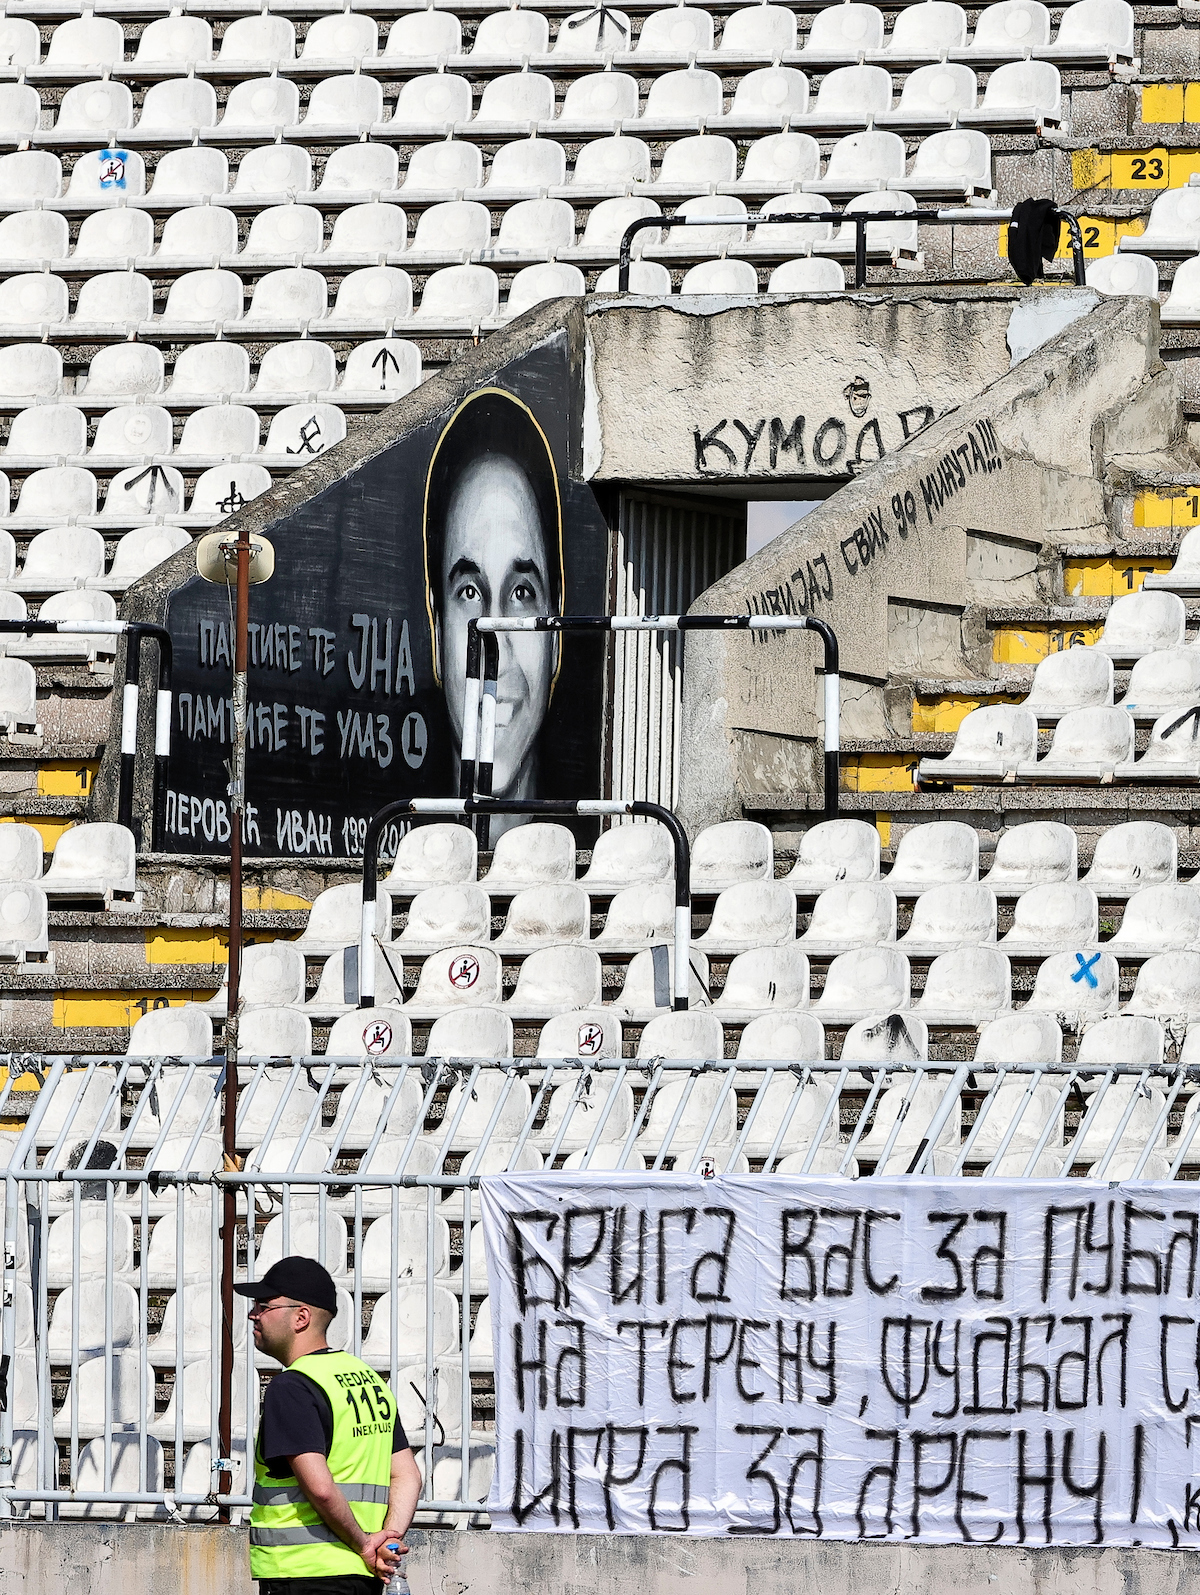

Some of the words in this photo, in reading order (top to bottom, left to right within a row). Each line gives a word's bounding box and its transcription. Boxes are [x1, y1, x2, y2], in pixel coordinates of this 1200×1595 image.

[1131, 158, 1164, 180] 23
[308, 627, 337, 676] ТЕ
[294, 704, 326, 756] ТЕ
[337, 709, 394, 769] УЛАЗ
[276, 808, 333, 855] ИВАН
[346, 1385, 391, 1424] 115
[353, 1425, 373, 1438] INEX
